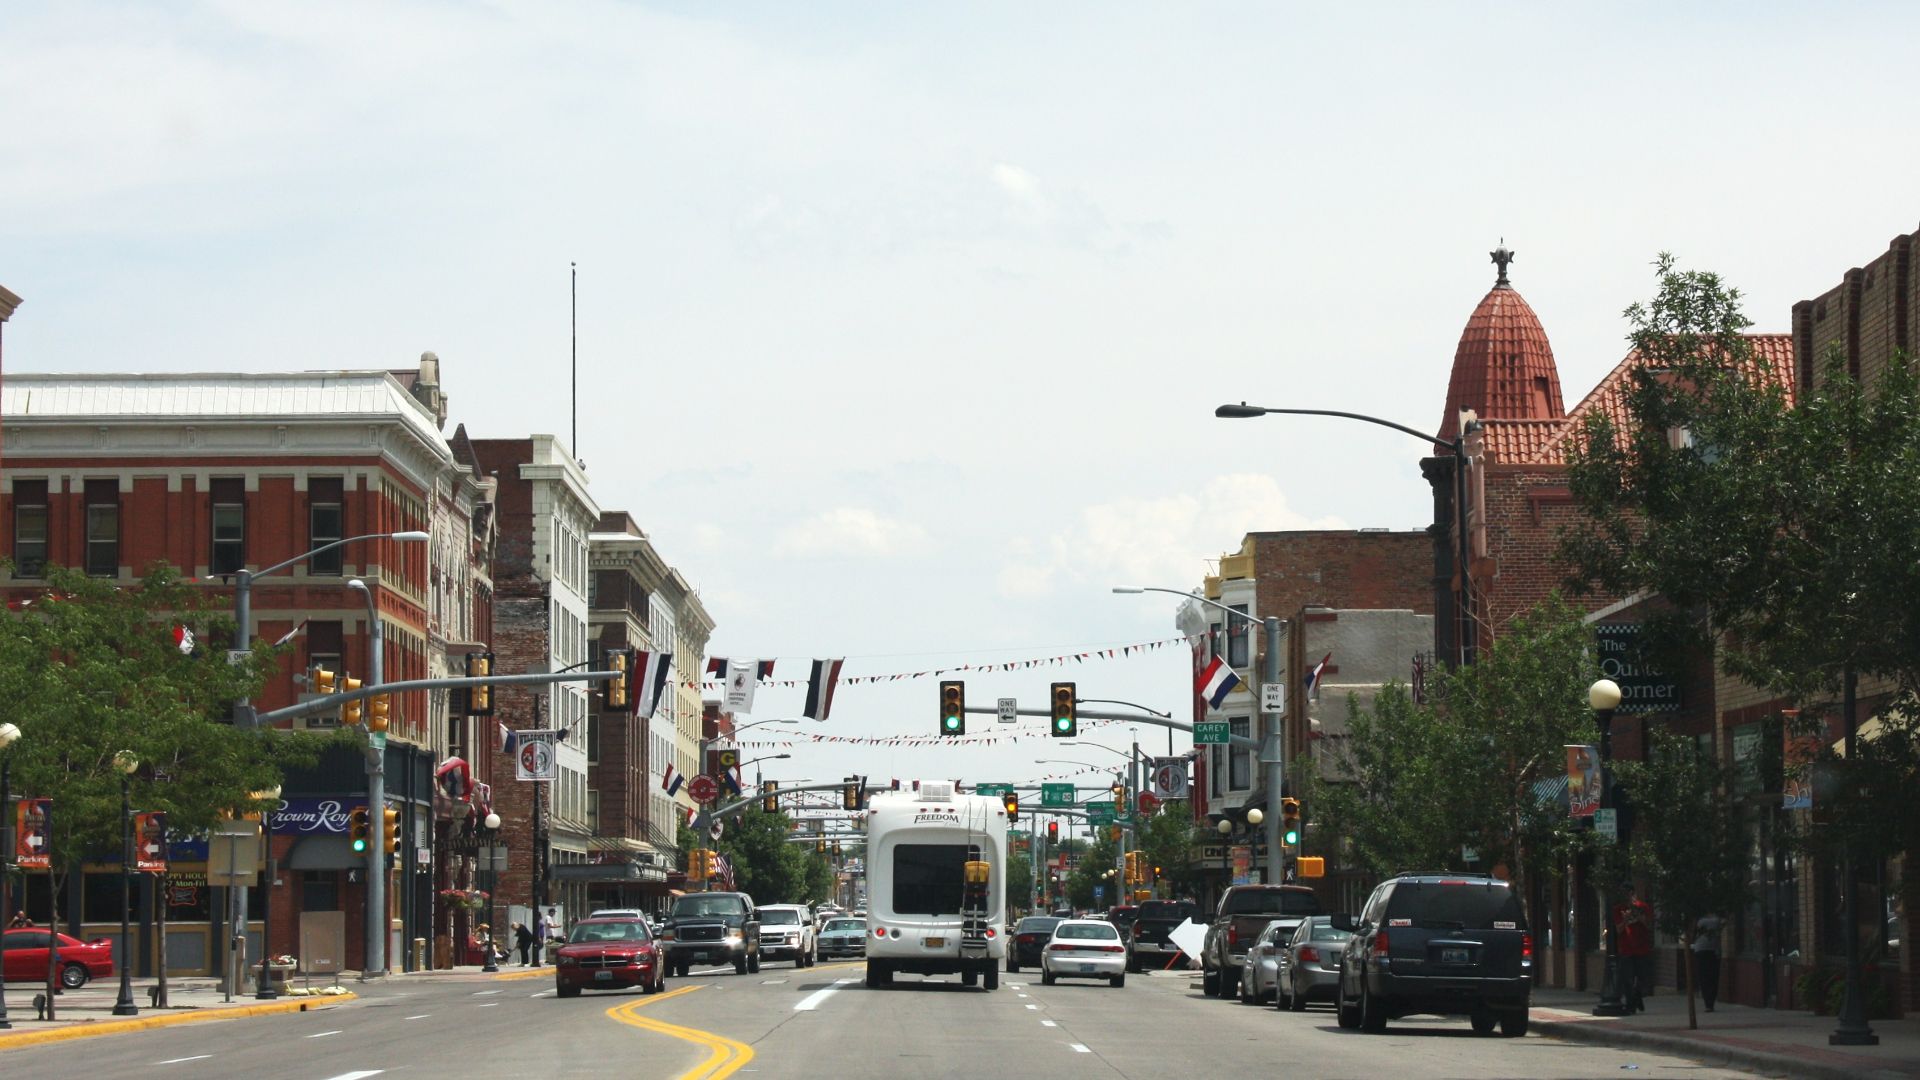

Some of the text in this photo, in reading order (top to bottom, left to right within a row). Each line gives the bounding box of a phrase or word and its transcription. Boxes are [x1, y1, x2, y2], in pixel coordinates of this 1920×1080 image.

[1602, 640, 1627, 651] The
[1620, 684, 1675, 698] orner
[1197, 724, 1225, 732] CAREY
[914, 814, 959, 824] FREEDOM
[17, 855, 49, 863] Parking
